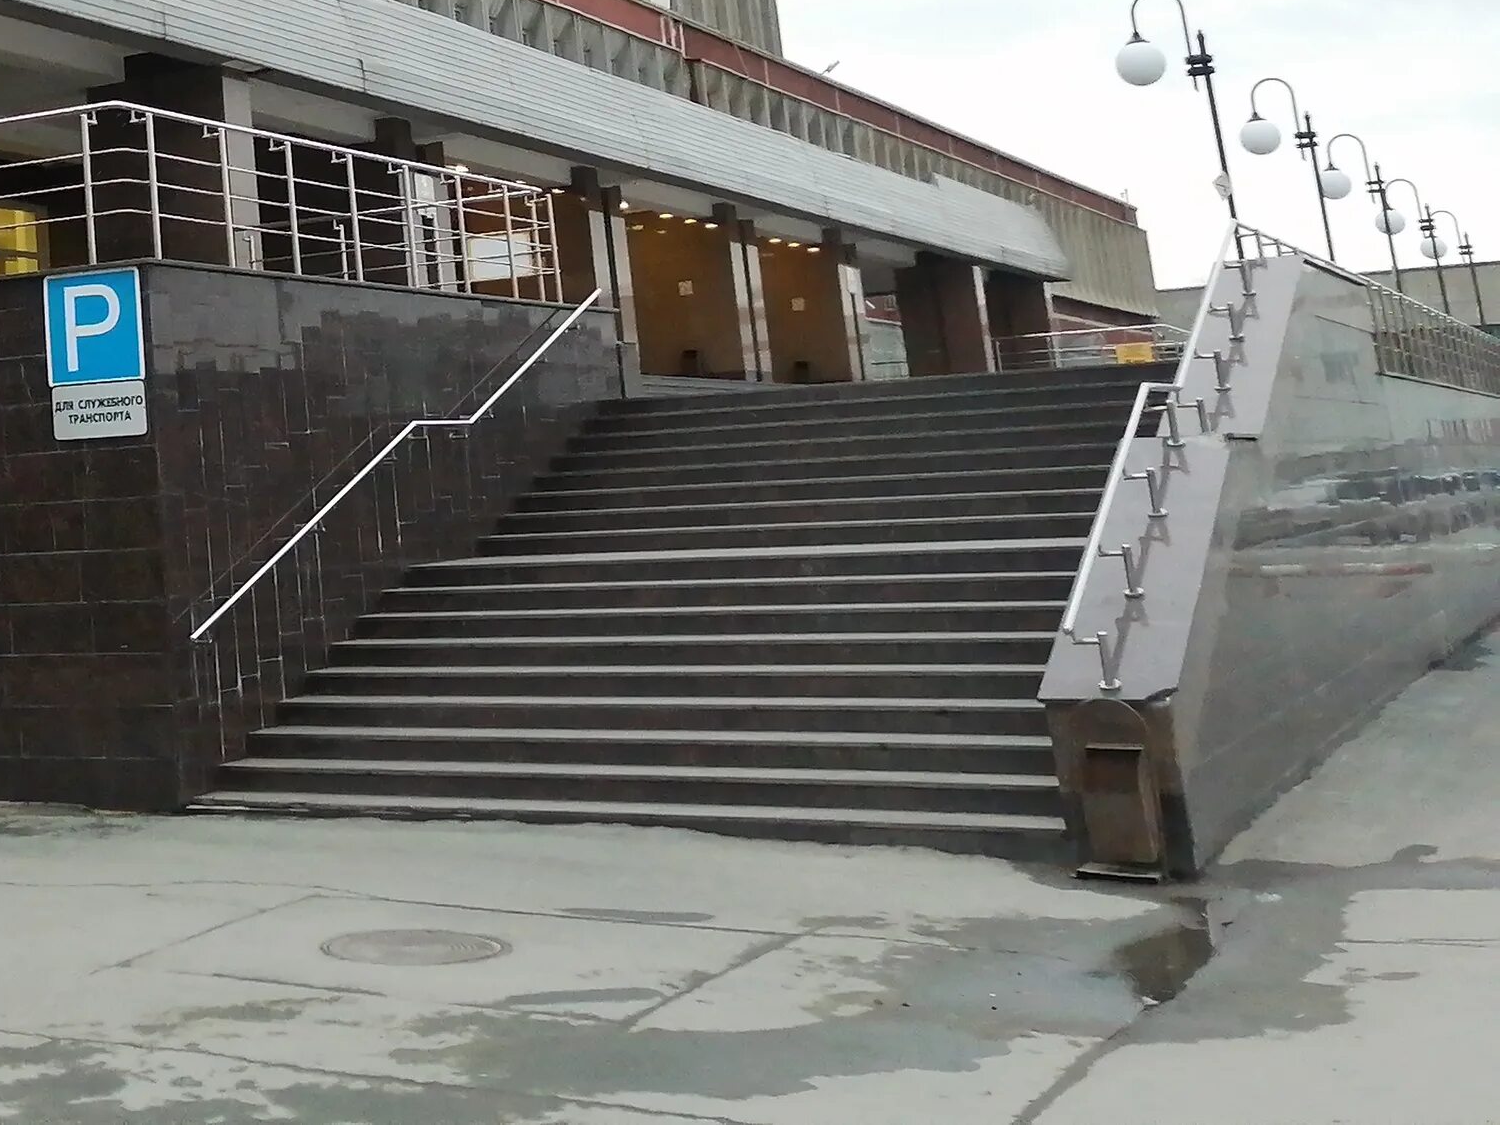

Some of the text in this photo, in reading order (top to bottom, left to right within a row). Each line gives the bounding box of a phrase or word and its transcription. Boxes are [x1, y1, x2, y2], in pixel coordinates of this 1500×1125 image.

[63, 283, 121, 372] P
[54, 394, 144, 413] ДЛЯ СЛУЖЕБНОГО
[67, 410, 132, 425] ТРАНСПОРТА
